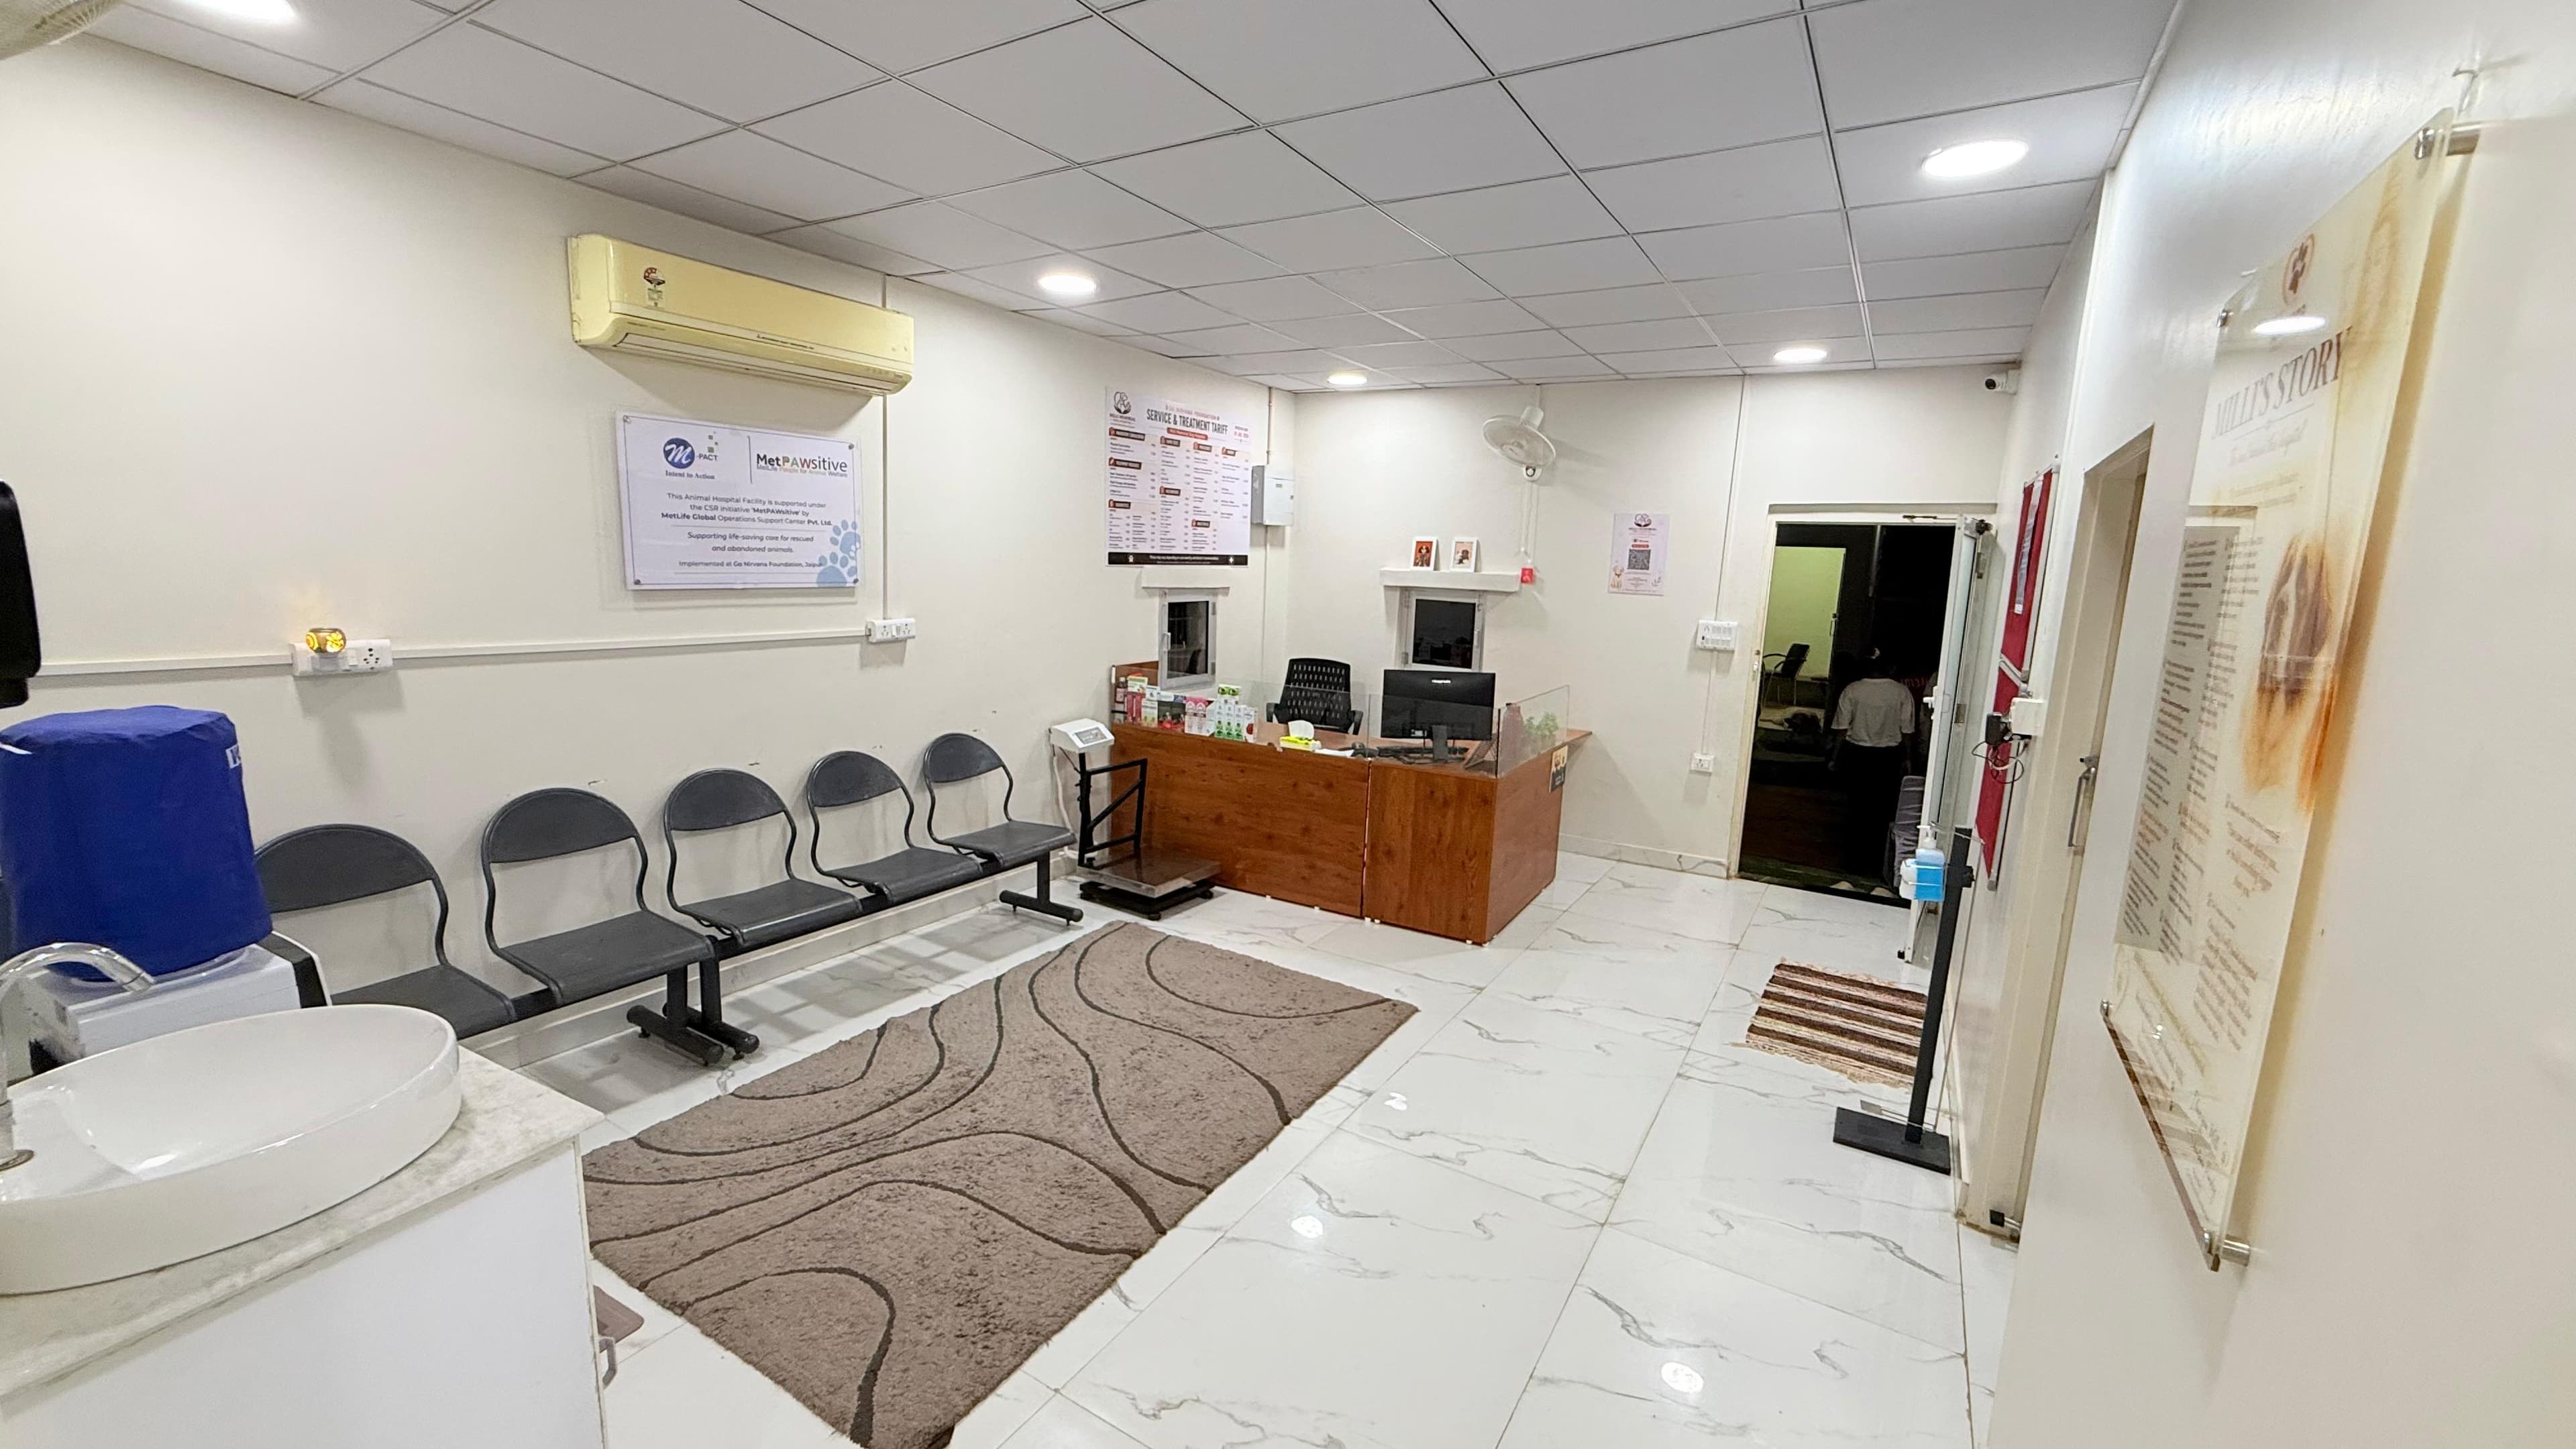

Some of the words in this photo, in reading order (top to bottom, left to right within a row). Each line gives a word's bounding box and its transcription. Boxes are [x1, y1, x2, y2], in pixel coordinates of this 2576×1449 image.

[2211, 372, 2274, 439] MILLI'S
[2274, 325, 2353, 409] STORY
[1146, 408, 1172, 424] SERVICE
[1173, 415, 1178, 425] &
[1179, 415, 1210, 431] TREATMENT
[1211, 421, 1228, 435] TARIFF
[756, 453, 848, 472] MetPAWsitive
[743, 497, 766, 506] Facility
[661, 512, 690, 520] MetLife
[718, 515, 756, 523] Operations
[687, 531, 727, 541] Supporting
[729, 533, 764, 542] life-saving
